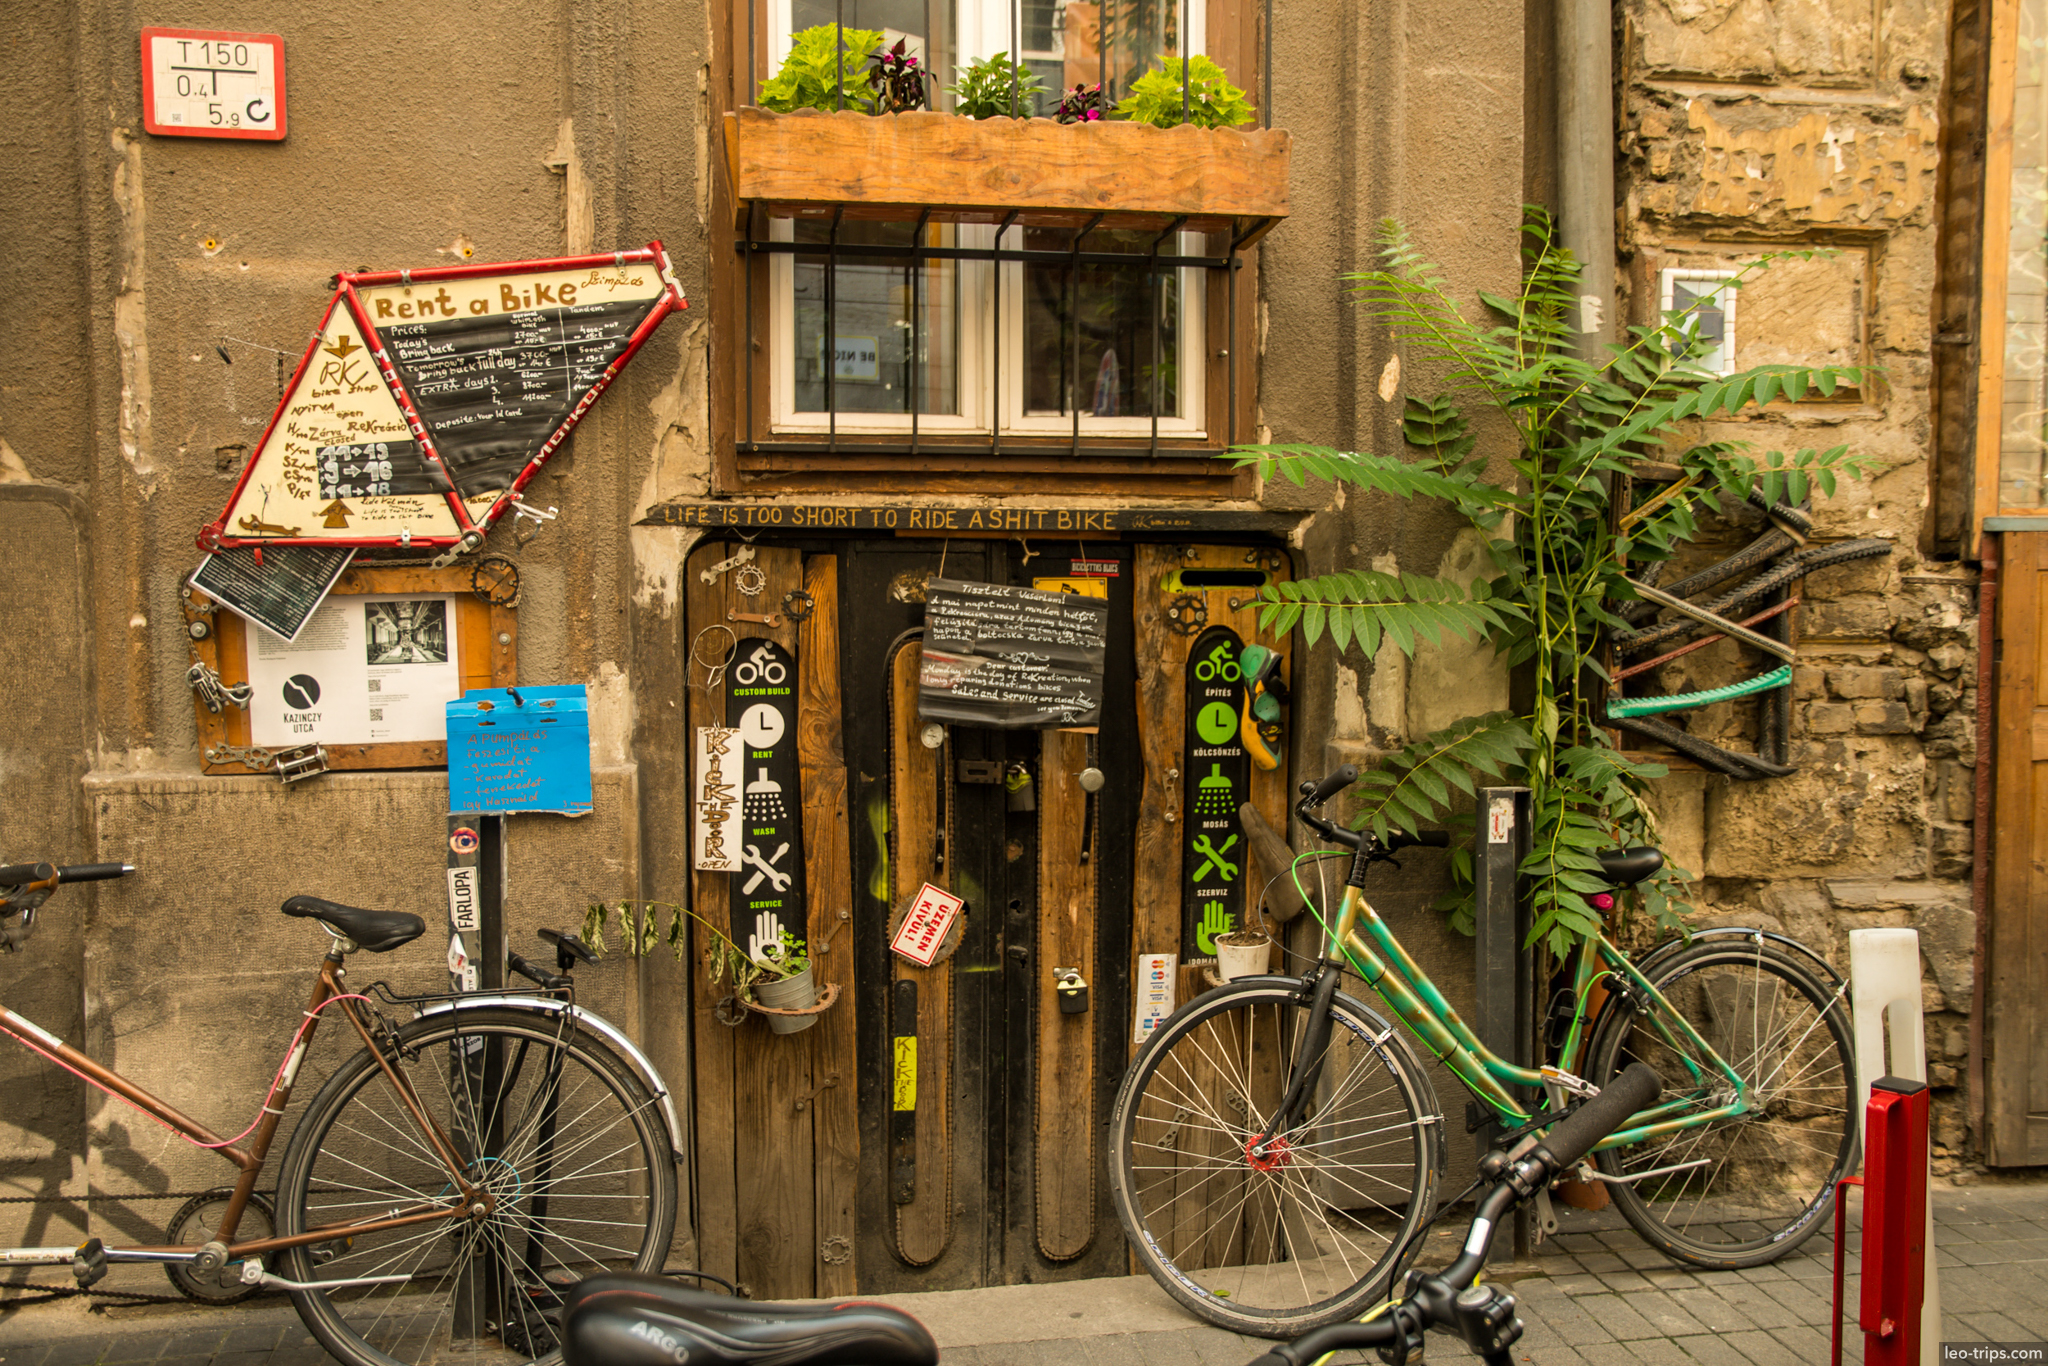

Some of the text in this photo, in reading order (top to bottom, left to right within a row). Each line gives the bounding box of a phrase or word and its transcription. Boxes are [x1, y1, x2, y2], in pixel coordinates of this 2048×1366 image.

[177, 75, 207, 98] 0.4
[209, 103, 240, 126] 5.9
[375, 283, 577, 319] Rent a Bike
[391, 325, 428, 336] Prices:
[393, 337, 428, 350] Today's
[496, 356, 517, 370] day
[312, 385, 378, 398] bike shop
[420, 379, 460, 396] EXTRA
[363, 461, 393, 481] 16
[366, 482, 391, 497] 18
[665, 506, 711, 523] LIFE
[722, 507, 738, 524] IS
[744, 507, 782, 524] TOO
[792, 506, 862, 526] SHORT
[871, 509, 897, 527] TO
[909, 509, 958, 529] RIDE
[1058, 512, 1118, 530] BIKE
[734, 687, 790, 696] CUSTOM BUILD
[980, 689, 999, 700] and
[1205, 688, 1232, 697] ÉPÍTÉS
[283, 712, 322, 724] KAZINCZY
[293, 723, 314, 733] UTCA
[1193, 747, 1241, 757] KÖLCSÖNZÉS
[1203, 819, 1229, 829] MOSÁS
[753, 827, 776, 836] WASH
[1197, 888, 1229, 897] SZERVIZ
[454, 870, 474, 929] FARLOPA
[750, 900, 782, 909] SERVICE
[917, 904, 951, 952] ÜZEMEN
[631, 1321, 689, 1364] ARGO
